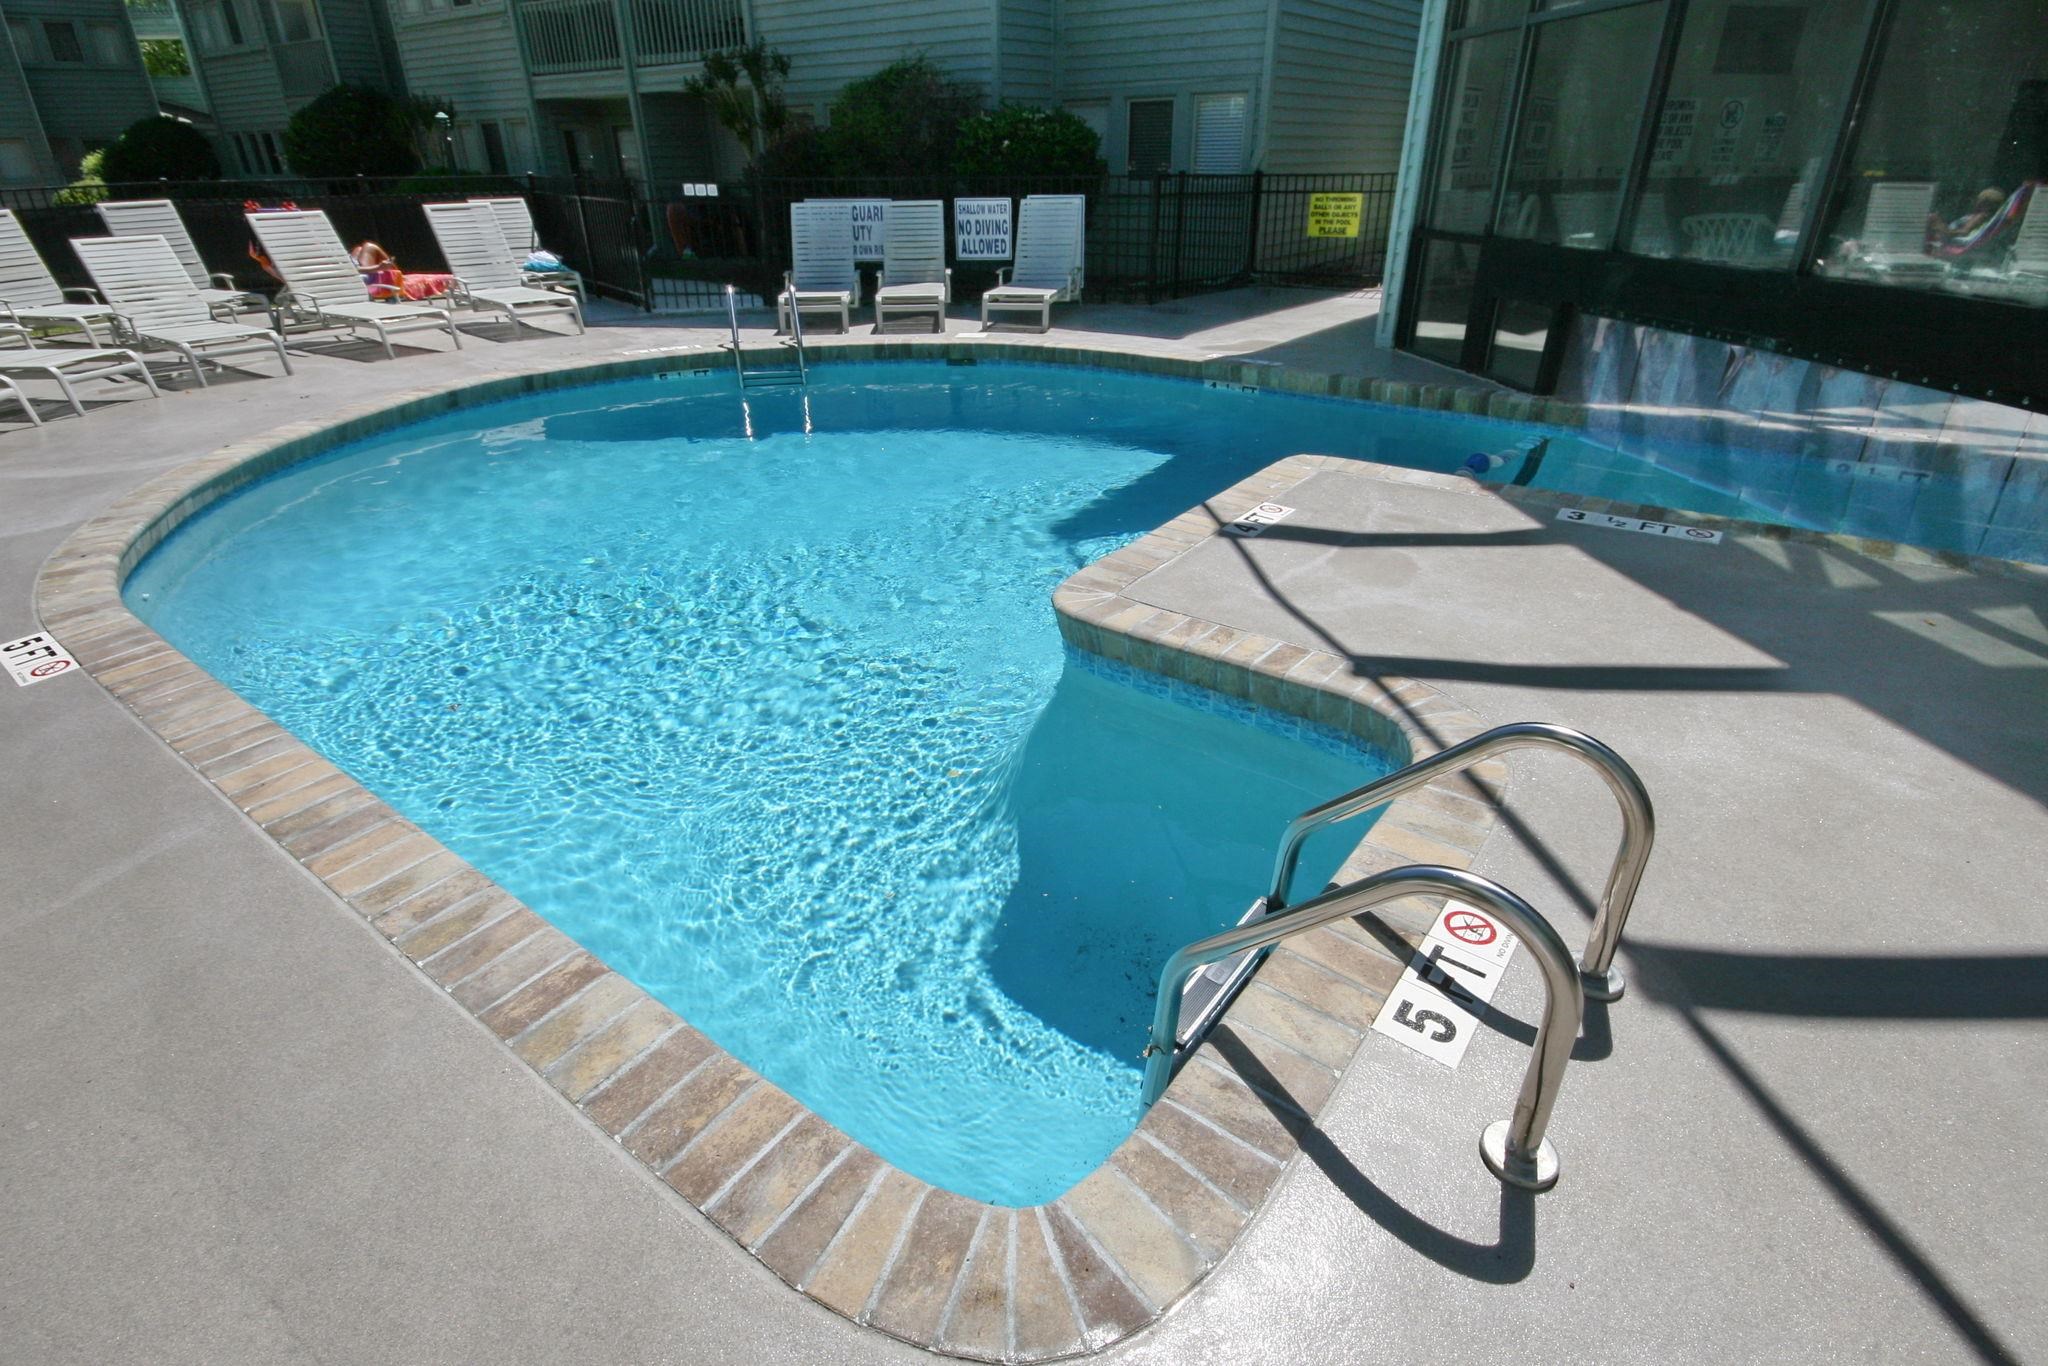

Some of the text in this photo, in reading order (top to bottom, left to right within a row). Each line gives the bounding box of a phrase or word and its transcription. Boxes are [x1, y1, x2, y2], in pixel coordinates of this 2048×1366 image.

[852, 204, 884, 222] GUAR
[958, 203, 1008, 215] SHALLOW WATER
[852, 224, 873, 241] UTY
[958, 219, 1009, 236] NO DIVING
[1319, 226, 1347, 235] PLEASE
[961, 238, 1007, 255] ALLOWED
[1243, 512, 1275, 526] FT
[1567, 511, 1586, 521] 3
[1638, 521, 1676, 535] FT
[2, 636, 58, 667] 5 FT
[1391, 944, 1487, 1043] 5 FT
